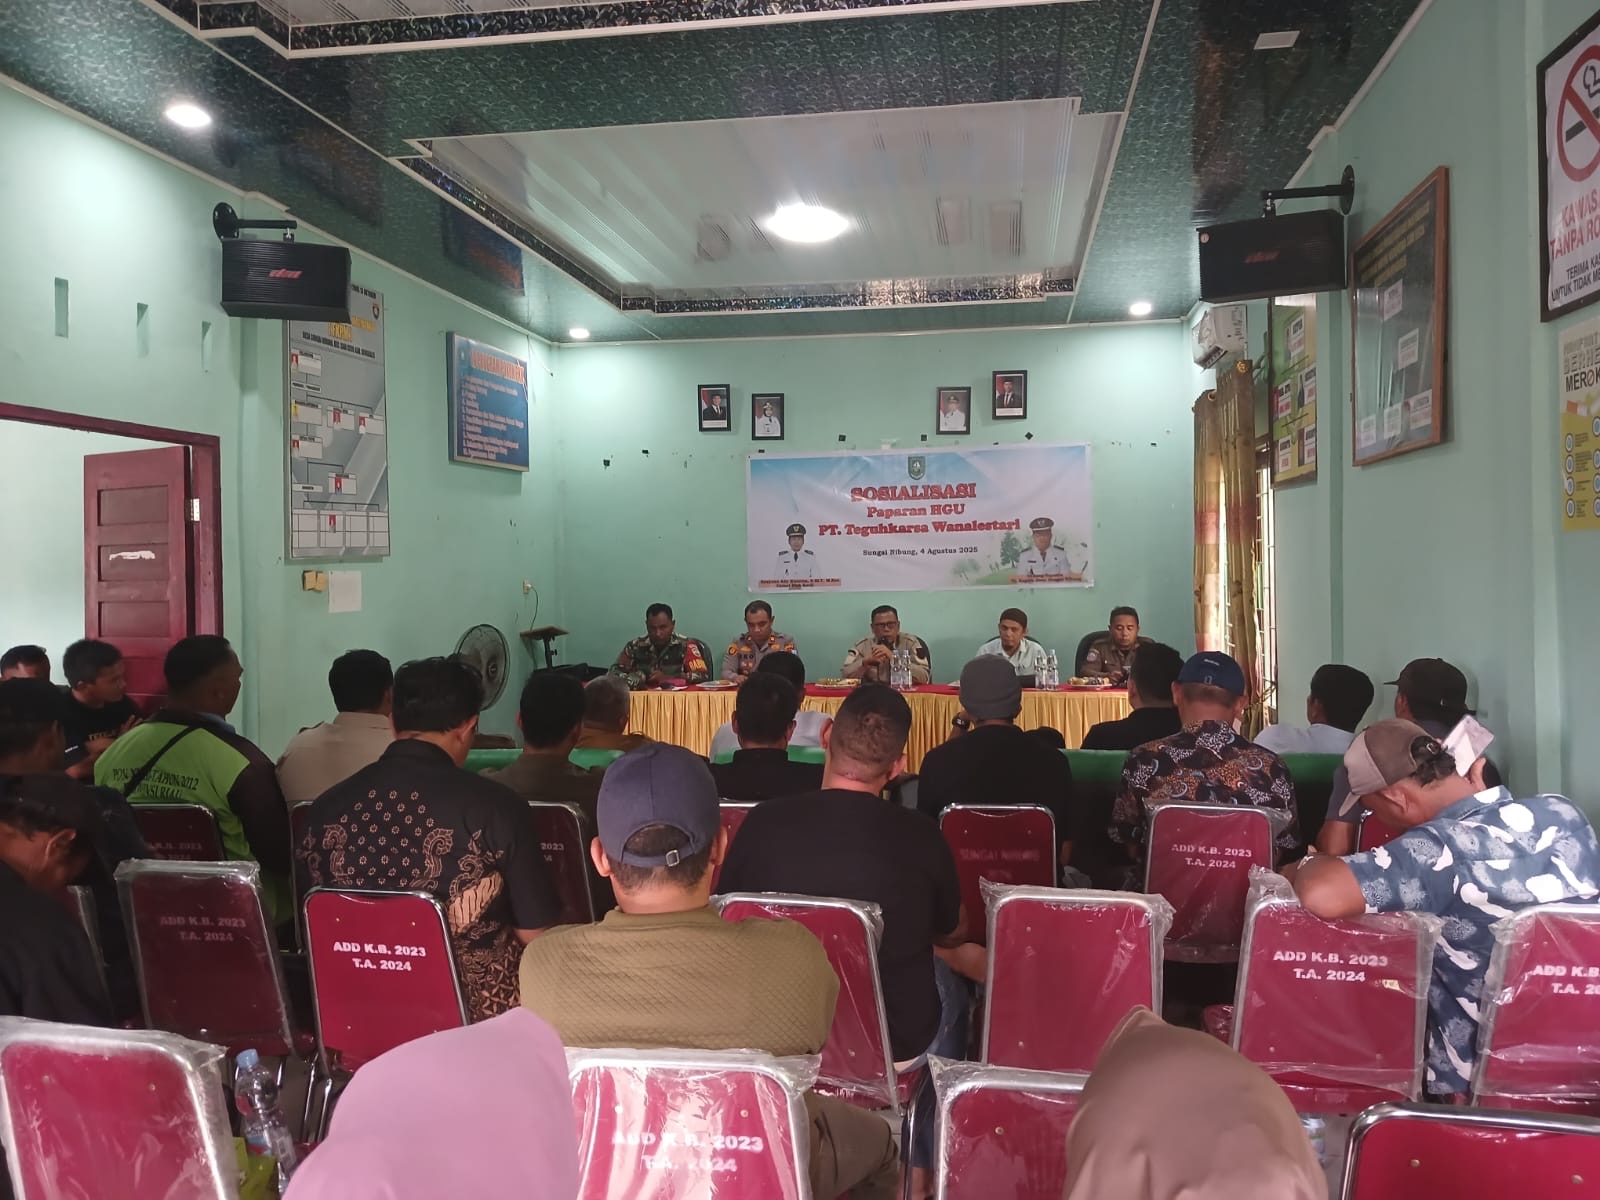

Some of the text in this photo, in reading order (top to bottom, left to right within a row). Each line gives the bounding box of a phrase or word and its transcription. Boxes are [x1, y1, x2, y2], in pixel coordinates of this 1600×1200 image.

[1562, 187, 1600, 228] KAWAS
[1550, 226, 1584, 261] TANPA
[1566, 259, 1589, 280] TERIMA
[1551, 280, 1573, 301] UNTUK
[1574, 270, 1592, 291] TIDAK
[850, 482, 977, 502] SOSIALISASI
[867, 503, 966, 519] Paparan HGU
[818, 524, 842, 536] PT.
[845, 522, 929, 537] Teguhkarsa
[862, 548, 888, 557] Sungai
[926, 547, 957, 556] Agustus
[958, 546, 979, 554] 2025
[180, 775, 199, 791] 2012
[1172, 843, 1196, 854] ADD
[1223, 846, 1252, 858] 2023
[1185, 857, 1236, 869] T.A. 2024
[159, 916, 186, 927] ADD
[217, 917, 247, 928] 2023
[179, 931, 234, 942] T.A. 2024
[333, 941, 426, 957] ADD K.B. 2023
[352, 957, 412, 971] T.A. 2024
[1273, 950, 1388, 967] ADD K.B. 2023
[1293, 968, 1366, 982] T.A. 2024
[1532, 964, 1567, 977] ADD
[1552, 983, 1580, 995] T.A.
[611, 1131, 656, 1145] ADD
[712, 1135, 764, 1152] 2023
[687, 1157, 738, 1172] 2024
